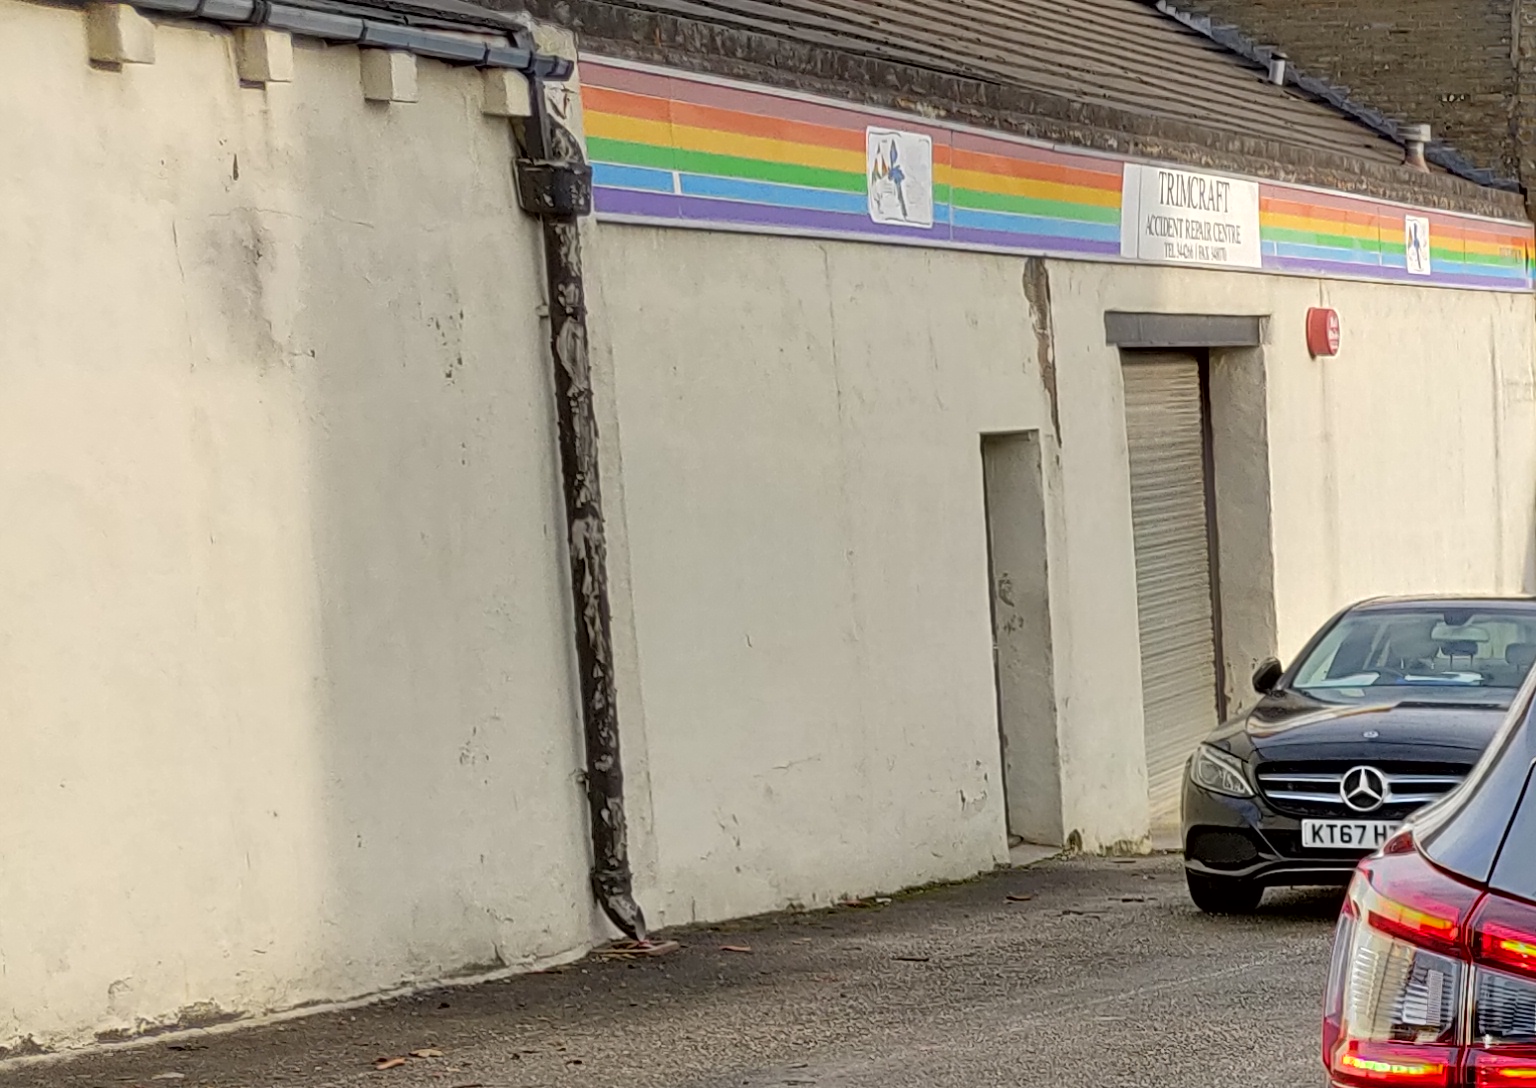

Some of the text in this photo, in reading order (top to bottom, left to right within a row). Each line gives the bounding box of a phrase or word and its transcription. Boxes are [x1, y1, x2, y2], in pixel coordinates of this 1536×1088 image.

[1159, 171, 1230, 213] TRIMCRAFT
[1146, 214, 1241, 244] ACCIDENT REPAIR CENTRE
[1312, 824, 1367, 844] KT67
